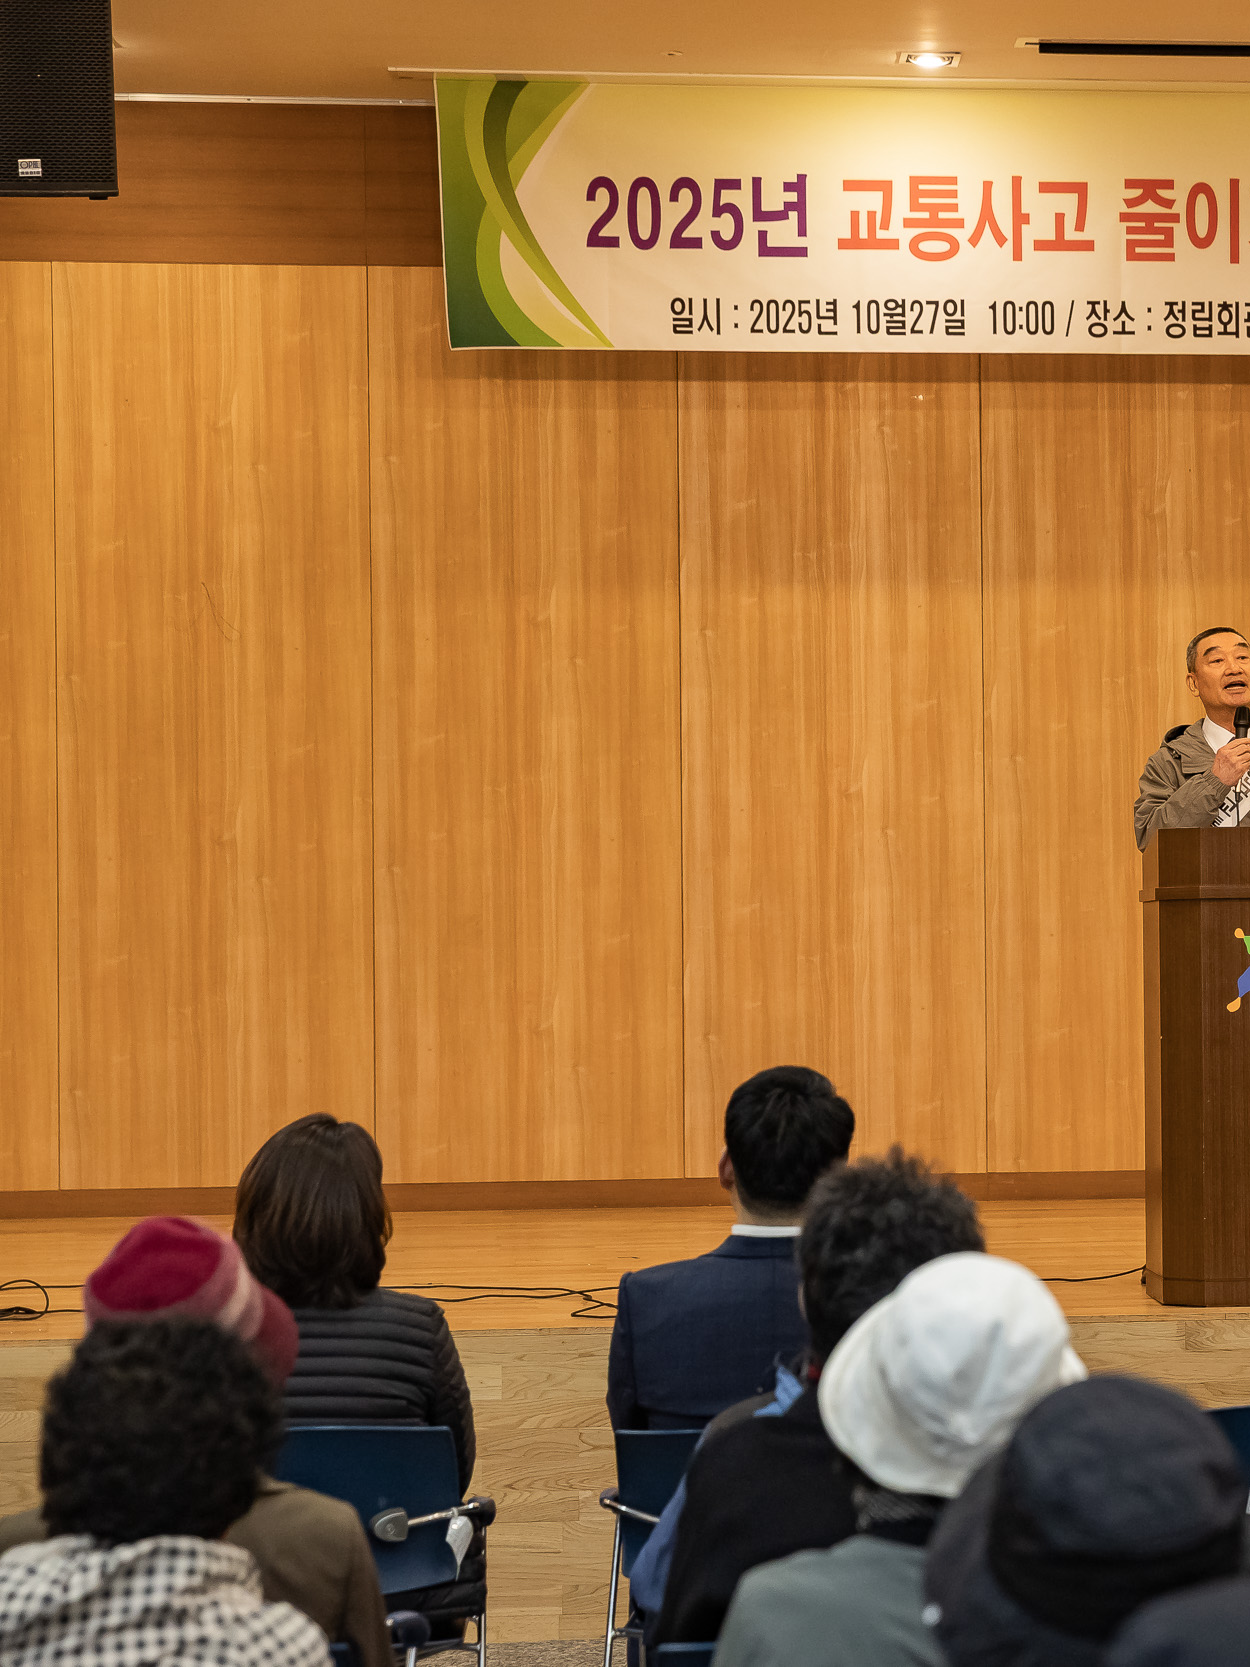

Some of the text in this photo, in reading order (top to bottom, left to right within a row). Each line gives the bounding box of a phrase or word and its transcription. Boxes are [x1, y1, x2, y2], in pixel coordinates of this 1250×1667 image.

[585, 173, 809, 258] 2025년
[837, 175, 1095, 262] 교통사고
[670, 296, 723, 336] 일시
[749, 298, 838, 336] 2025년
[851, 298, 966, 337] 10월27일
[988, 300, 1055, 336] 10:00
[1085, 299, 1136, 339] 장소
